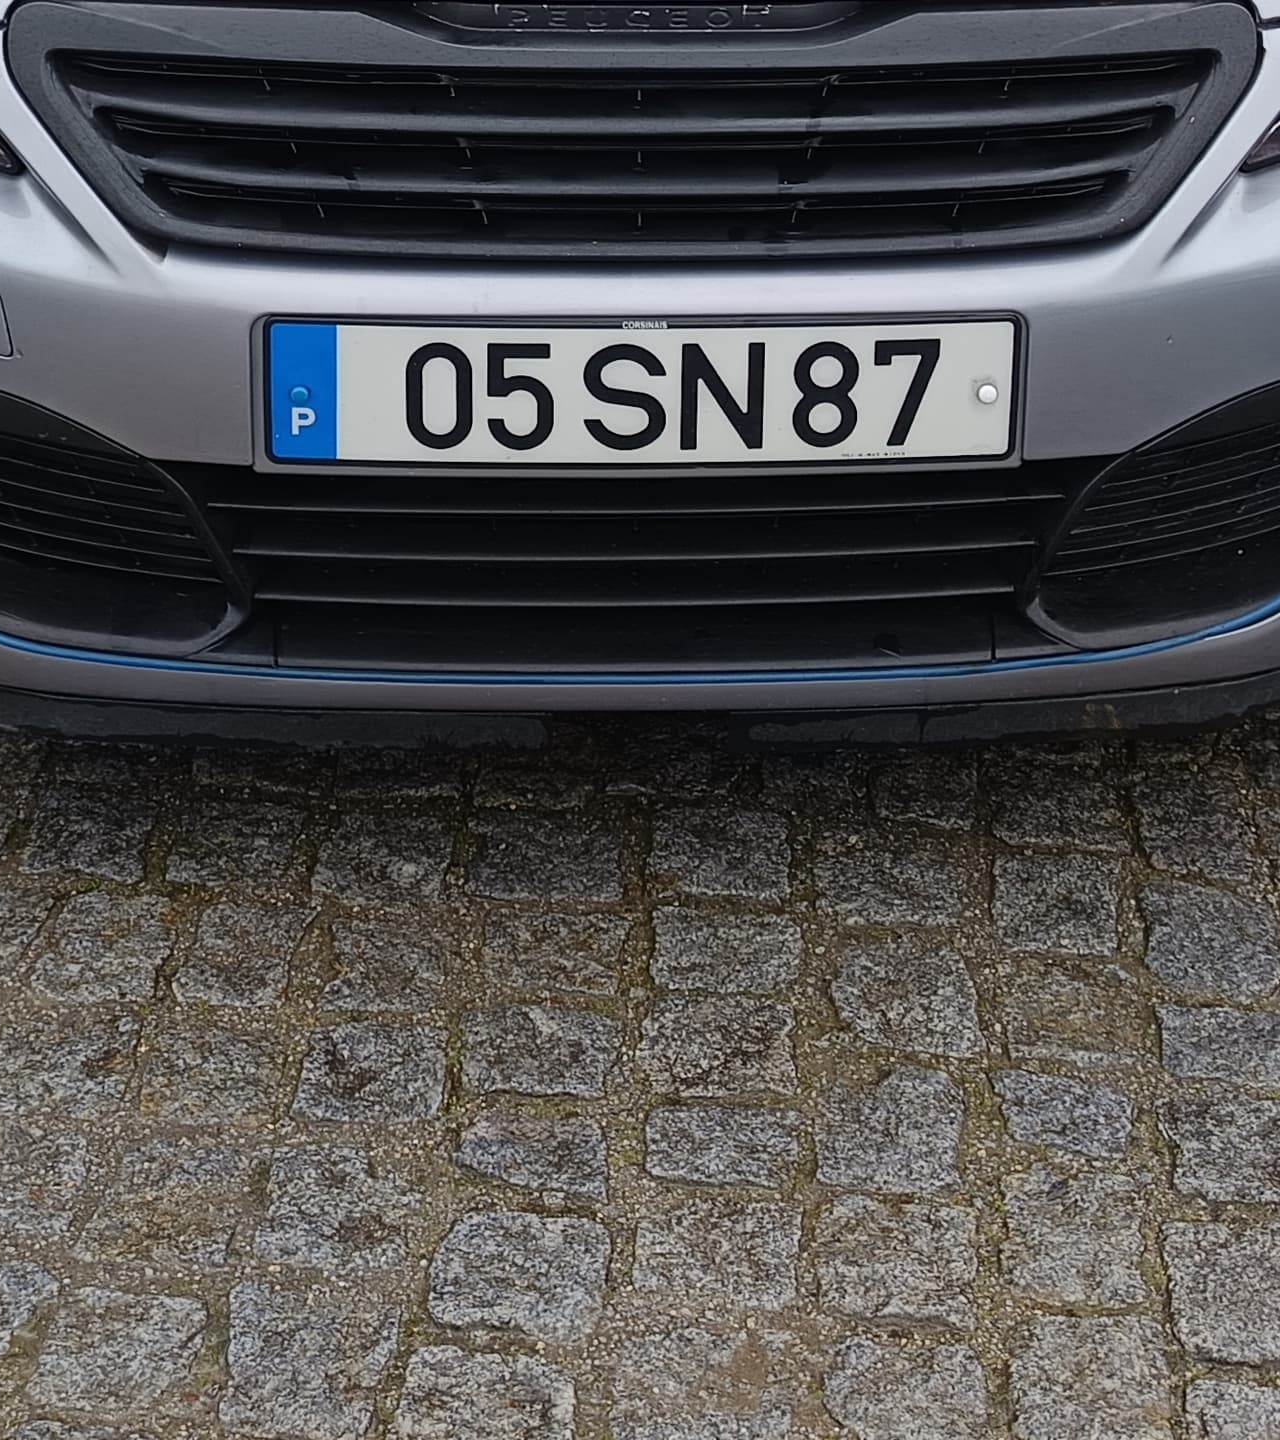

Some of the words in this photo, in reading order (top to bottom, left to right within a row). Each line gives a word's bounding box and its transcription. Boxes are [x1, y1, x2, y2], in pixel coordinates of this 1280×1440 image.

[291, 406, 316, 436] P
[405, 342, 555, 451] 05
[582, 341, 766, 451] SN
[791, 338, 941, 448] 87
